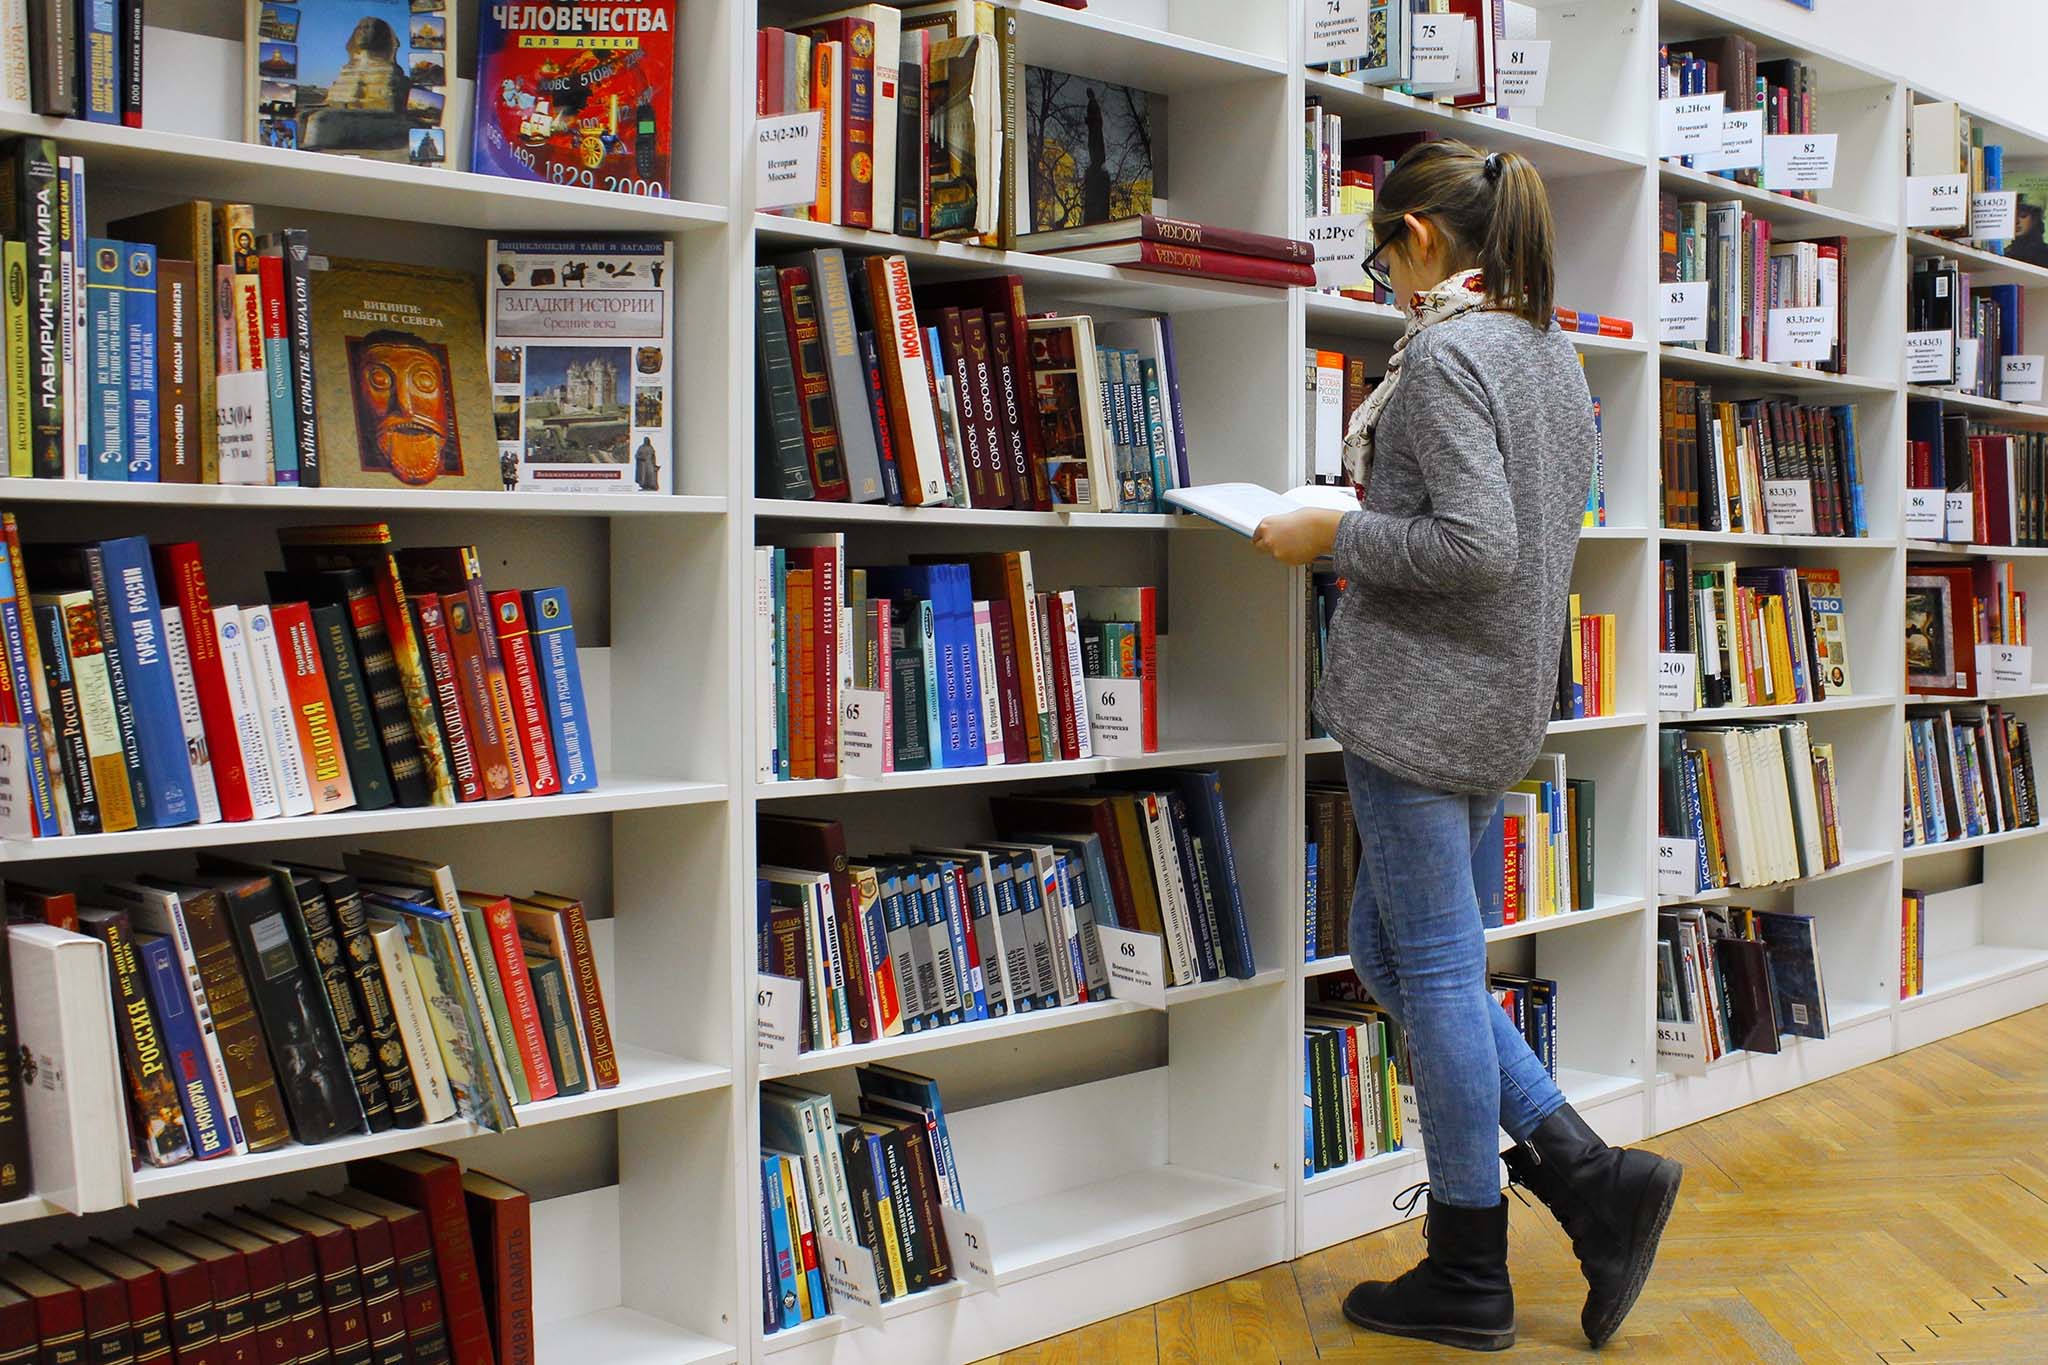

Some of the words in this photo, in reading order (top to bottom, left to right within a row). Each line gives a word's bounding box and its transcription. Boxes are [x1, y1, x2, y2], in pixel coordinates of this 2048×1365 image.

[493, 6, 668, 32] ЧЕЛОВЕЧЕСТВА
[1315, 17, 1358, 29] Образование.
[1327, 1, 1340, 14] 74
[524, 38, 560, 46] ДЛЯ
[576, 39, 633, 47] ДЕТЕЙ
[1422, 25, 1436, 39] 75
[1511, 51, 1525, 64] 81
[131, 84, 140, 106] 1000
[1675, 104, 1711, 114] 81.2Нем
[509, 142, 536, 173] 1492
[544, 161, 594, 190] 1829
[768, 159, 797, 170] История
[1803, 143, 1815, 154] 82
[60, 180, 71, 203] САМ!
[768, 172, 796, 182] Москвы
[1932, 185, 1958, 196] 85.14
[37, 188, 53, 257] МИРА
[60, 204, 71, 241] СДЕЛАЙ
[1156, 223, 1202, 244] МОСКВА
[1308, 226, 1355, 242] 81.2Рус
[499, 242, 575, 251] ЭНЦИКЛОПЕДИЯ
[581, 243, 605, 251] ТАЙН
[1155, 249, 1201, 268] МОСКВА
[823, 256, 846, 307] ВОЕННАЯ
[891, 260, 914, 309] ВОЕННАЯ
[1671, 292, 1684, 304] 83
[175, 282, 184, 337] ВСЕМИРНАЯ
[272, 298, 281, 319] мир
[296, 275, 311, 348] ЗАБРАЛОМ
[343, 309, 388, 323] НАБЕГИ
[391, 312, 399, 323] С
[401, 314, 444, 328] СЕВЕРА
[363, 300, 421, 315] ВИКИНГИ:
[505, 297, 575, 314] ЗАГАДКИ
[580, 297, 654, 313] ИСТОРИИ
[543, 317, 591, 331] Средние
[593, 319, 616, 329] века
[16, 313, 25, 343] МИРА
[38, 260, 58, 410] ЛАБИРИНТЫ
[830, 309, 856, 357] МОСКВА
[901, 309, 921, 359] МОСКВА
[1907, 339, 1942, 348] 85.143(3)
[17, 346, 27, 398] ДРЕВНЕГО
[174, 342, 183, 383] ИСТОРИЯ
[2007, 363, 2032, 371] 85.37
[299, 350, 313, 415] СКРЫТЫЕ
[957, 357, 973, 418] СОРОКОВ
[977, 362, 993, 422] СОРОКОВ
[1002, 365, 1018, 424] СОРОКОВ
[1113, 383, 1122, 420] ИСТОРИЯ
[1130, 384, 1139, 422] ИСТОРИЯ
[1149, 394, 1161, 422] МИР
[19, 401, 29, 450] ИСТОРИЯ
[175, 404, 185, 465] СПРАВОЧНИК
[1154, 425, 1166, 459] ВЕСЬ
[967, 423, 982, 469] СОРОК
[987, 426, 1001, 471] СОРОК
[1011, 431, 1026, 474] СОРОК
[1769, 488, 1797, 498] 83.3(3)
[1912, 497, 1924, 507] 86
[122, 567, 149, 613] РОССИИ
[192, 560, 213, 614] СССР
[1812, 599, 1840, 611] СТВО
[6, 607, 24, 660] ИСТОРИЯ
[16, 662, 33, 716] РОССИИ
[290, 626, 305, 676] Справочник
[329, 623, 348, 682] России
[1068, 639, 1079, 678] БИЗНЕС
[2001, 653, 2012, 662] 92
[945, 645, 956, 701] МОСКВИЧИ
[962, 644, 973, 701] МОСКВИЧИ
[108, 649, 124, 699] ЦАРСКИЕ
[117, 702, 141, 769] ДИНАСТИИ
[494, 678, 510, 722] ИМПЕРИЯ
[846, 703, 859, 719] 65
[1038, 676, 1046, 709] азбука
[1101, 691, 1116, 706] 66
[345, 684, 370, 751] История
[440, 682, 475, 778] ЭНЦИКЛОПЕДИЯ
[950, 710, 958, 729] ВСЕ
[968, 710, 976, 729] ВСЕ
[1066, 712, 1076, 750] РЫНОК:
[1074, 688, 1089, 750] ЭКОНОМИКА
[27, 723, 40, 753] АТЛАС
[506, 726, 524, 785] РОССИЙСКАЯ
[951, 730, 960, 750] МЫ
[969, 730, 977, 749] МЫ
[33, 757, 52, 820] ШКОЛЬНИКА
[1154, 824, 1167, 871] ВЫЖИВАНИЯ
[1660, 847, 1673, 858] 85
[1697, 818, 1711, 885] ИСКУССТВО
[1162, 872, 1180, 930] ЭНЦИКЛОПЕДИЯ
[107, 925, 128, 975] МОНАРХИ
[567, 907, 589, 956] КУЛЬТУРЫ
[1120, 942, 1136, 958] 68
[1174, 932, 1186, 968] БОЛЬШАЯ
[504, 933, 522, 975] ИСТОРИИ
[827, 914, 844, 987] ПРИЗЫВНИКА
[1033, 939, 1055, 992] ПРАВОСУДИЕ
[121, 976, 135, 996] ВСЕ
[580, 958, 602, 1006] РУССКОЙ
[899, 951, 920, 1014] АВТОЛЮБИТЕЛЯМ
[938, 948, 958, 1005] ЖЕНЩИНАМ
[986, 954, 1001, 985] ДЕТЯХ
[518, 979, 533, 1018] РУССКОЙ
[127, 997, 165, 1078] РОССИЯ
[588, 1009, 610, 1057] ИСТОРИЯ
[1658, 1029, 1687, 1042] 85.11
[186, 1079, 217, 1131] МОНАРХИ
[202, 1131, 221, 1152] ВСЕ
[965, 1232, 979, 1250] 72
[510, 1227, 524, 1301] ПАМЯТЬ
[835, 1257, 849, 1274] 71
[307, 1328, 315, 1339] 9
[345, 1318, 358, 1331] 10
[381, 1311, 392, 1324] 11
[276, 1338, 284, 1348] 8
